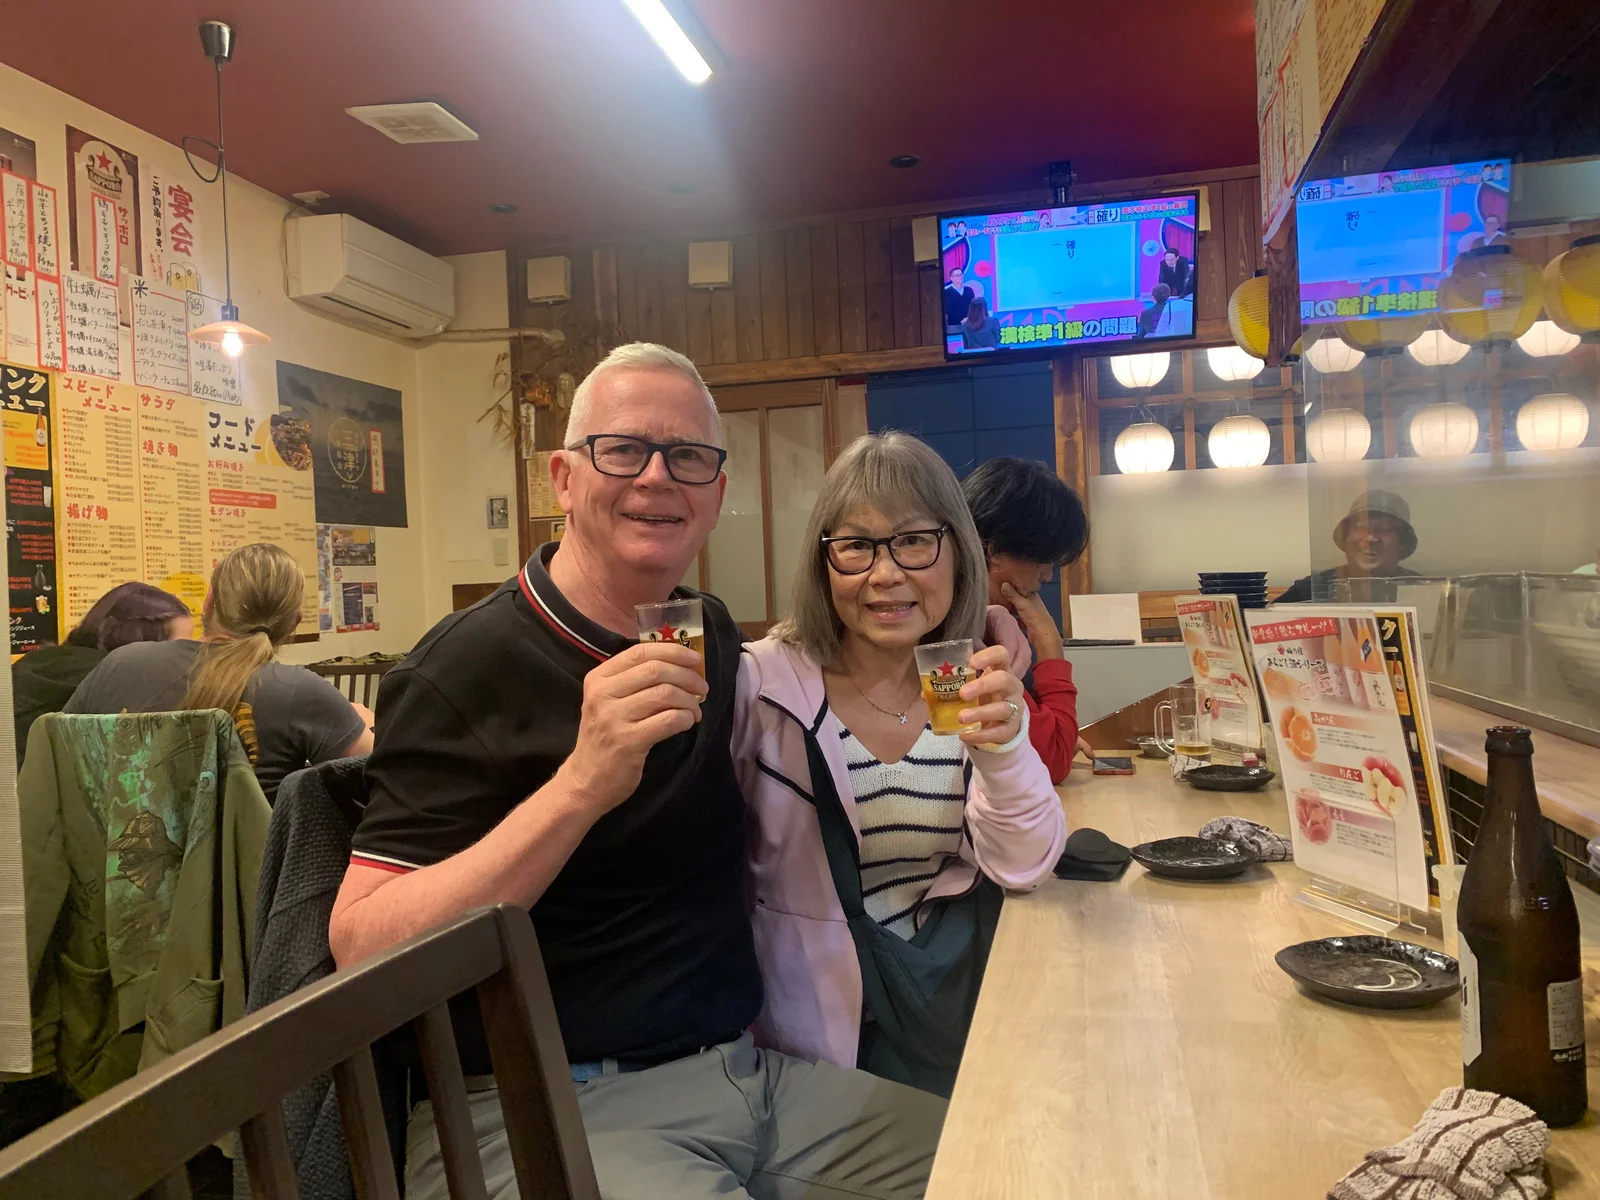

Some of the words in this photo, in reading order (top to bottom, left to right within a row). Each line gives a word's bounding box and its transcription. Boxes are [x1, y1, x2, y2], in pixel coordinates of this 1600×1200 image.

[89, 171, 122, 193] SAPPORO
[167, 184, 194, 257] 宴会
[1096, 208, 1120, 223] 確り
[117, 206, 129, 246] サッポロ
[1065, 239, 1077, 259] 確り
[1000, 316, 1138, 345] 漢検準1級の問題
[63, 377, 114, 399] スピード
[82, 397, 131, 413] メニュー
[140, 393, 176, 411] サラダ
[208, 412, 256, 436] フード
[142, 438, 179, 458] 焼き物
[209, 435, 262, 453] メニュー
[207, 459, 244, 472] お好み焼き
[66, 503, 109, 521] 揚げ物
[210, 506, 246, 519] モダン焼き
[211, 539, 238, 547] トッピング
[933, 680, 966, 692] SAPPORO
[1339, 767, 1360, 780] りんご
